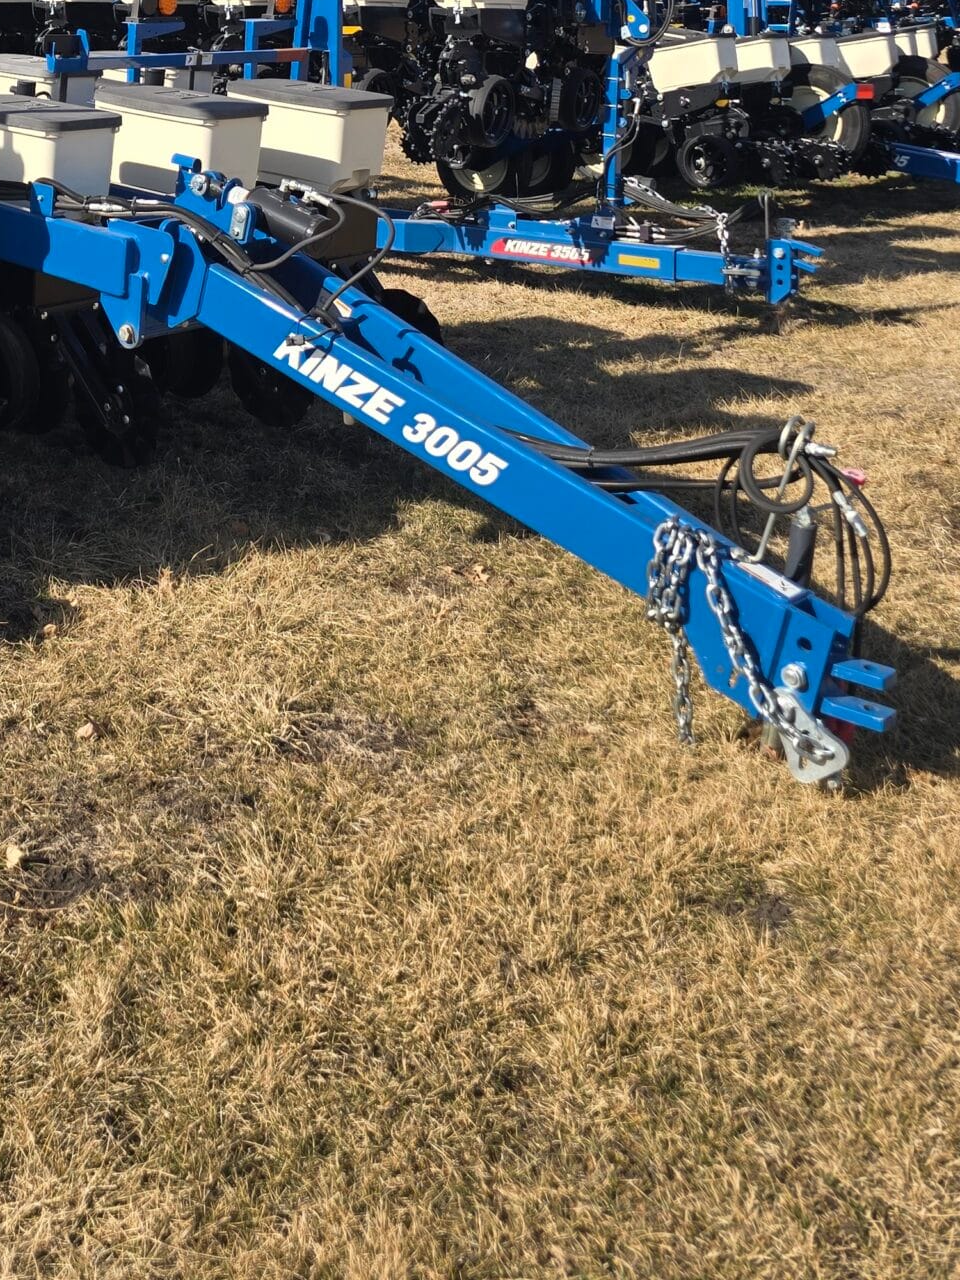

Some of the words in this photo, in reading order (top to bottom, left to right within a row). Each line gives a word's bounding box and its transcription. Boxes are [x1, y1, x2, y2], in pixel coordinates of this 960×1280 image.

[504, 239, 551, 256] KINZE
[273, 332, 406, 425] KINZE
[402, 413, 509, 486] 3005
